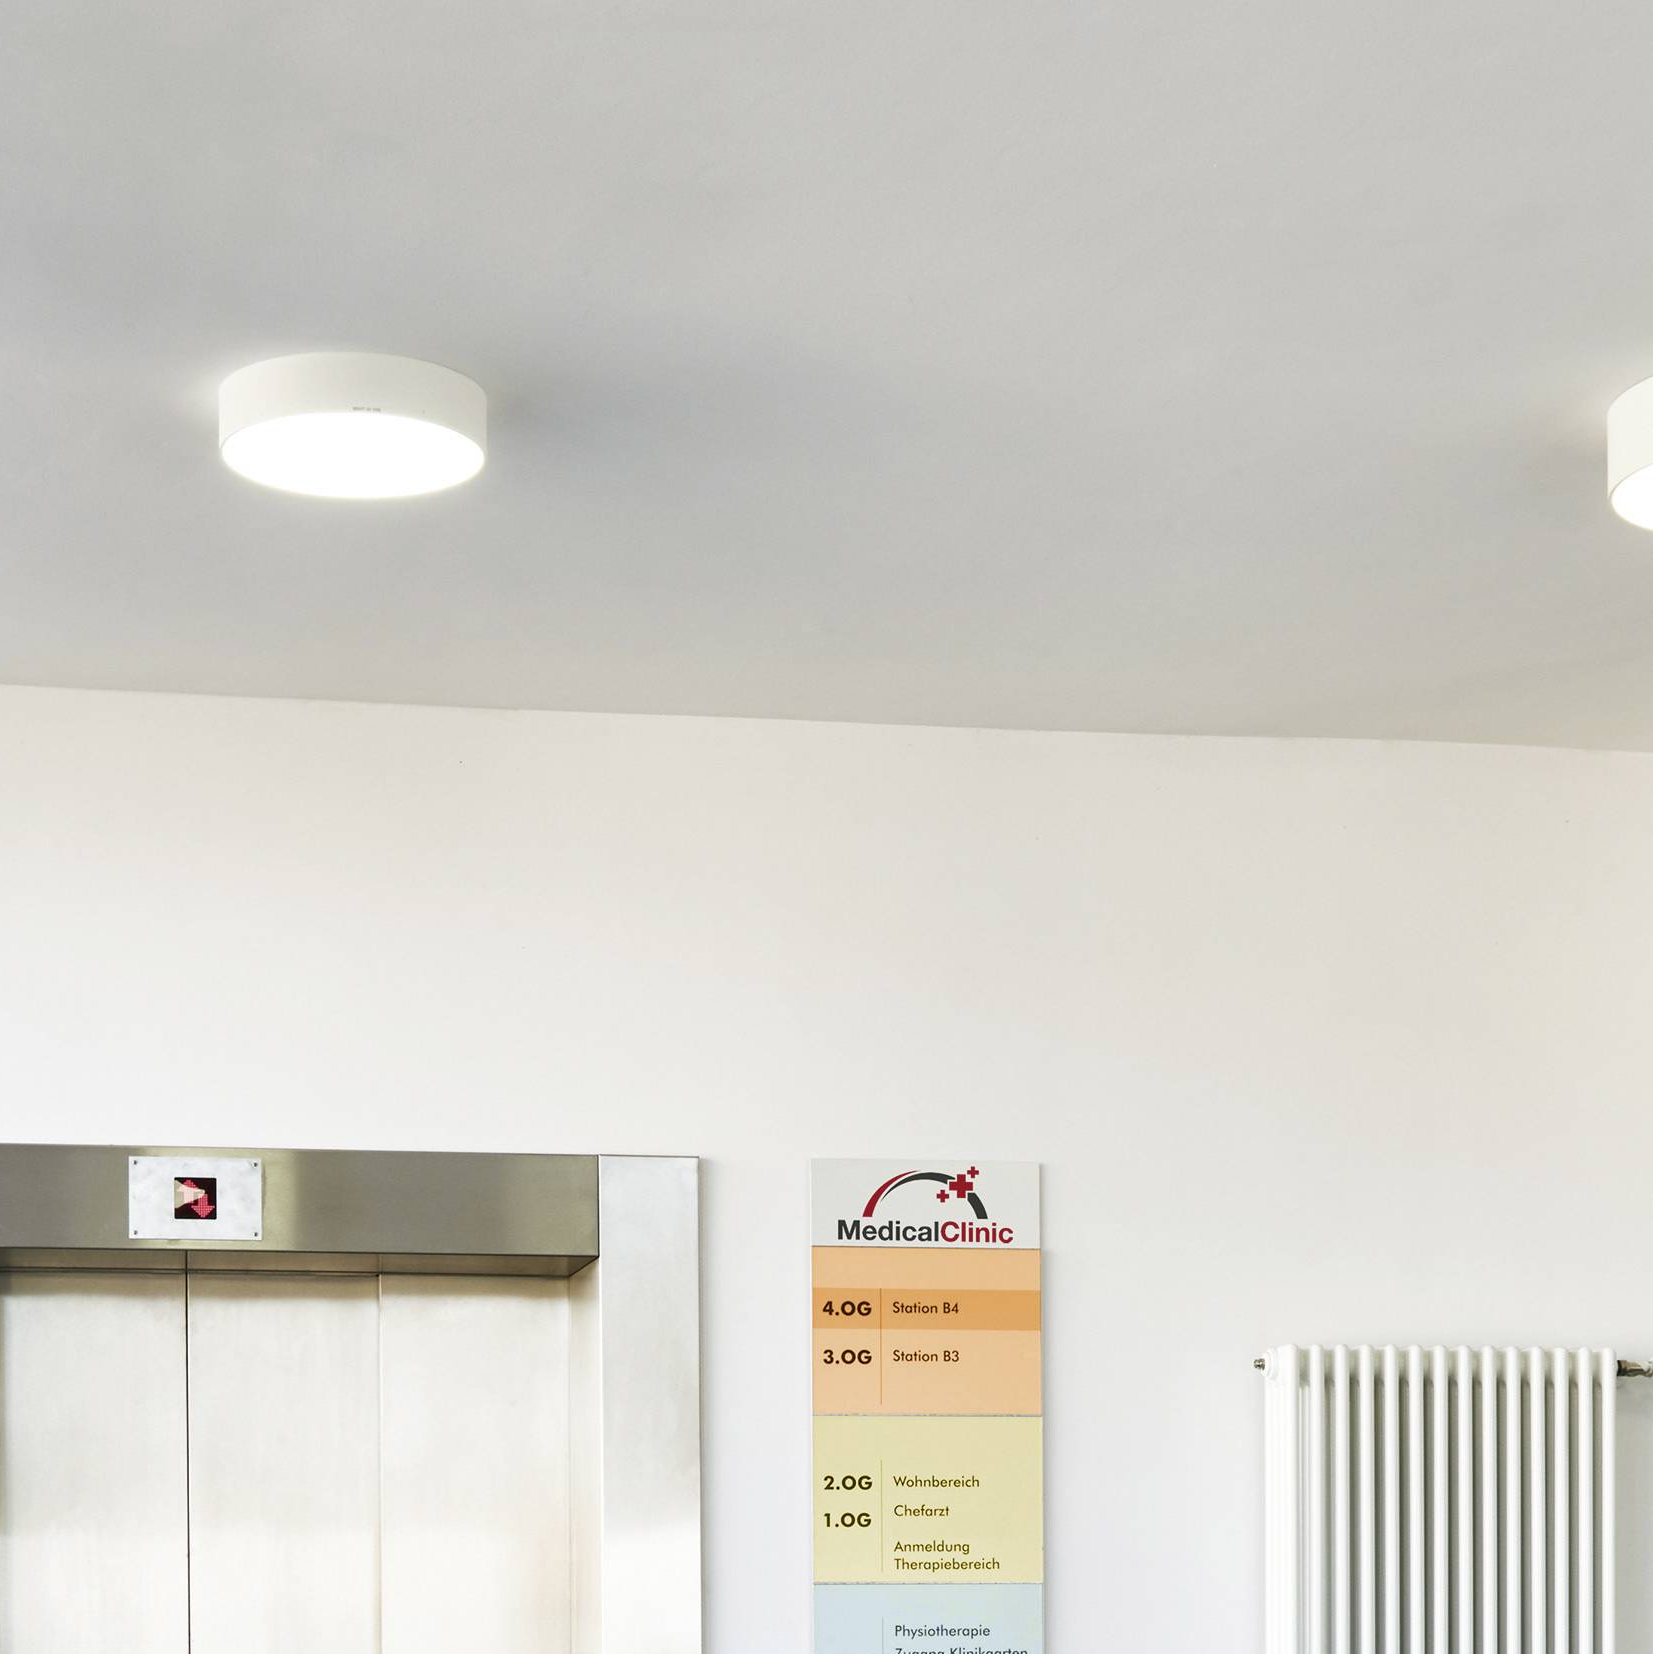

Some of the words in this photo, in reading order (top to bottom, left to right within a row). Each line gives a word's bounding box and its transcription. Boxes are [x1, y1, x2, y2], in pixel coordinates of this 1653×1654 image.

[837, 1219, 1014, 1244] MedicalClinic
[822, 1300, 872, 1317] 4.OG
[892, 1302, 938, 1314] Station
[942, 1302, 959, 1314] B4
[823, 1349, 872, 1366] 3.OG
[892, 1350, 938, 1363] Station
[943, 1350, 960, 1363] B3
[823, 1475, 873, 1491] 2.OG
[893, 1475, 980, 1488] Wohnbereich
[894, 1505, 949, 1517] Chefarzt
[824, 1513, 872, 1528] 1.OG
[894, 1540, 970, 1555] Anmeldung
[894, 1557, 1000, 1572] Therapiebereich
[895, 1625, 990, 1640] Physiotherapie
